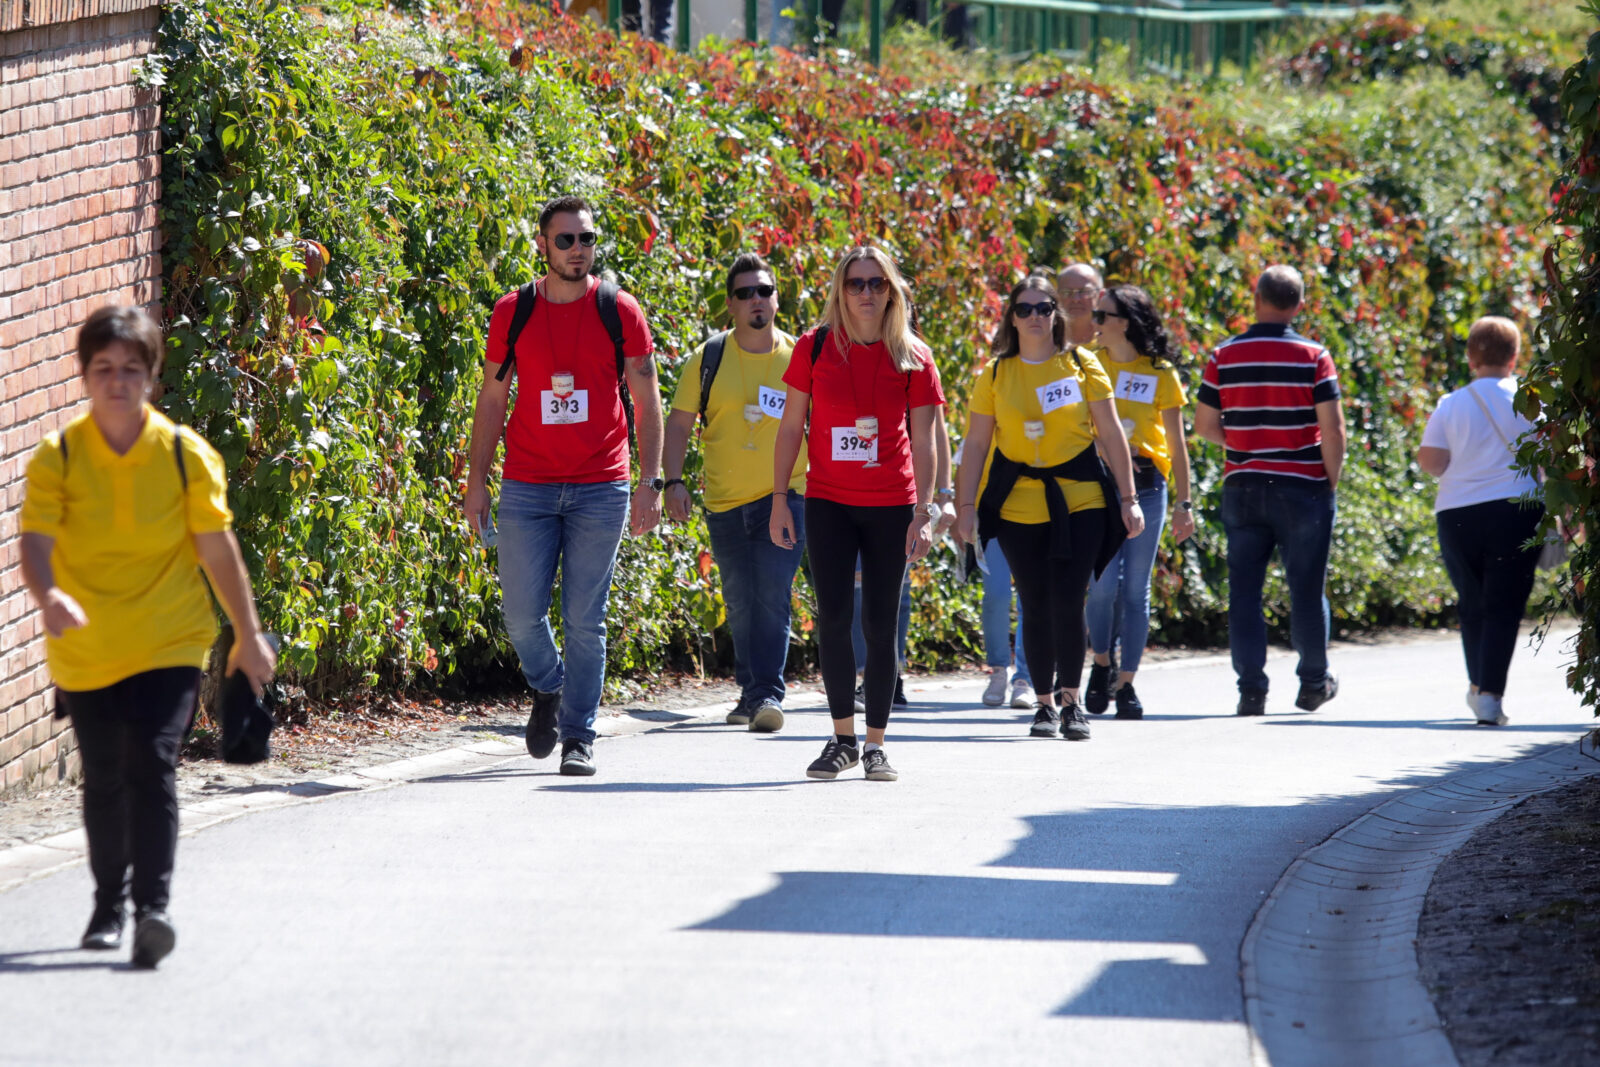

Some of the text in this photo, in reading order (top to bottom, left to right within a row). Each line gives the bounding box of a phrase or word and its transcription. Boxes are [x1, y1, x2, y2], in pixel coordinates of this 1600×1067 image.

[1046, 386, 1072, 402] 296
[1123, 381, 1149, 394] 297
[762, 393, 786, 410] 167
